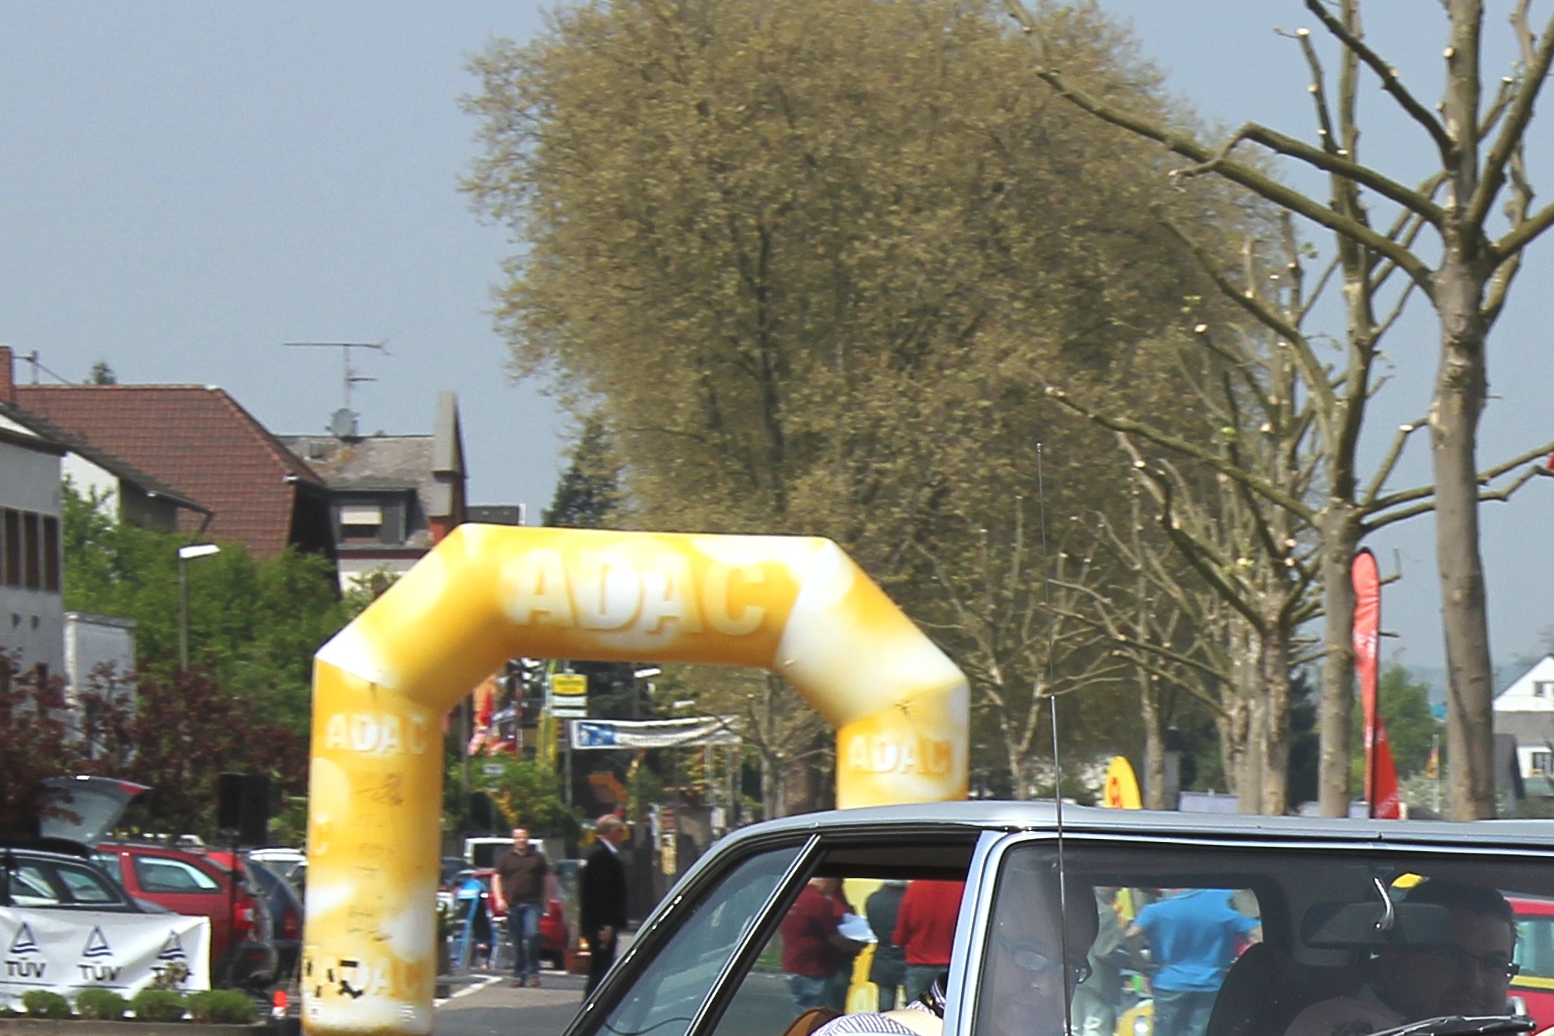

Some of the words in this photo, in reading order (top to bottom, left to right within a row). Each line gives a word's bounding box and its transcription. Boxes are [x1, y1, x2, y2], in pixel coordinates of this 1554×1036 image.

[504, 547, 767, 636] ADAC
[323, 712, 429, 755] ADAC
[847, 734, 952, 775] ADAC
[5, 957, 46, 978] TÜV
[77, 961, 122, 981] TÜV
